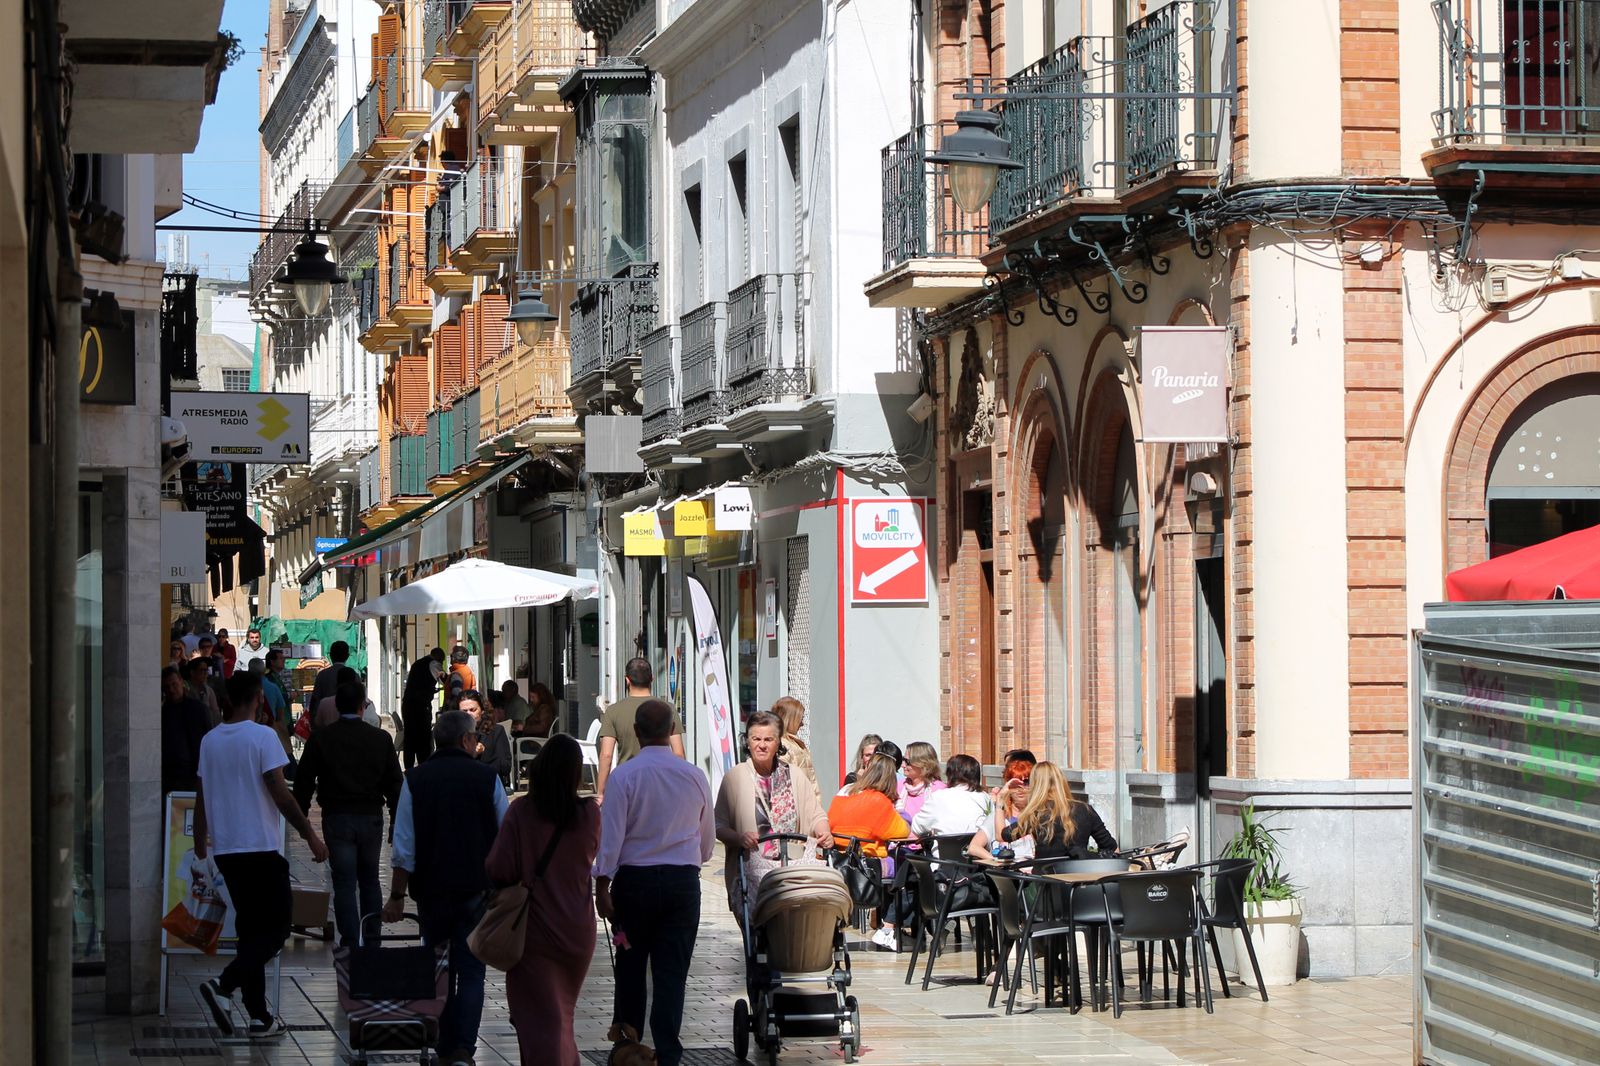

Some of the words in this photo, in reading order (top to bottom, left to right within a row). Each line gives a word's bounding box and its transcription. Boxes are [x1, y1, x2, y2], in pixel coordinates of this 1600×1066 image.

[1152, 366, 1218, 387] Panaria
[182, 409, 248, 417] ATRESMEDIA
[188, 484, 199, 492] EL
[194, 490, 241, 501] RTESANO
[723, 503, 750, 512] Lowi
